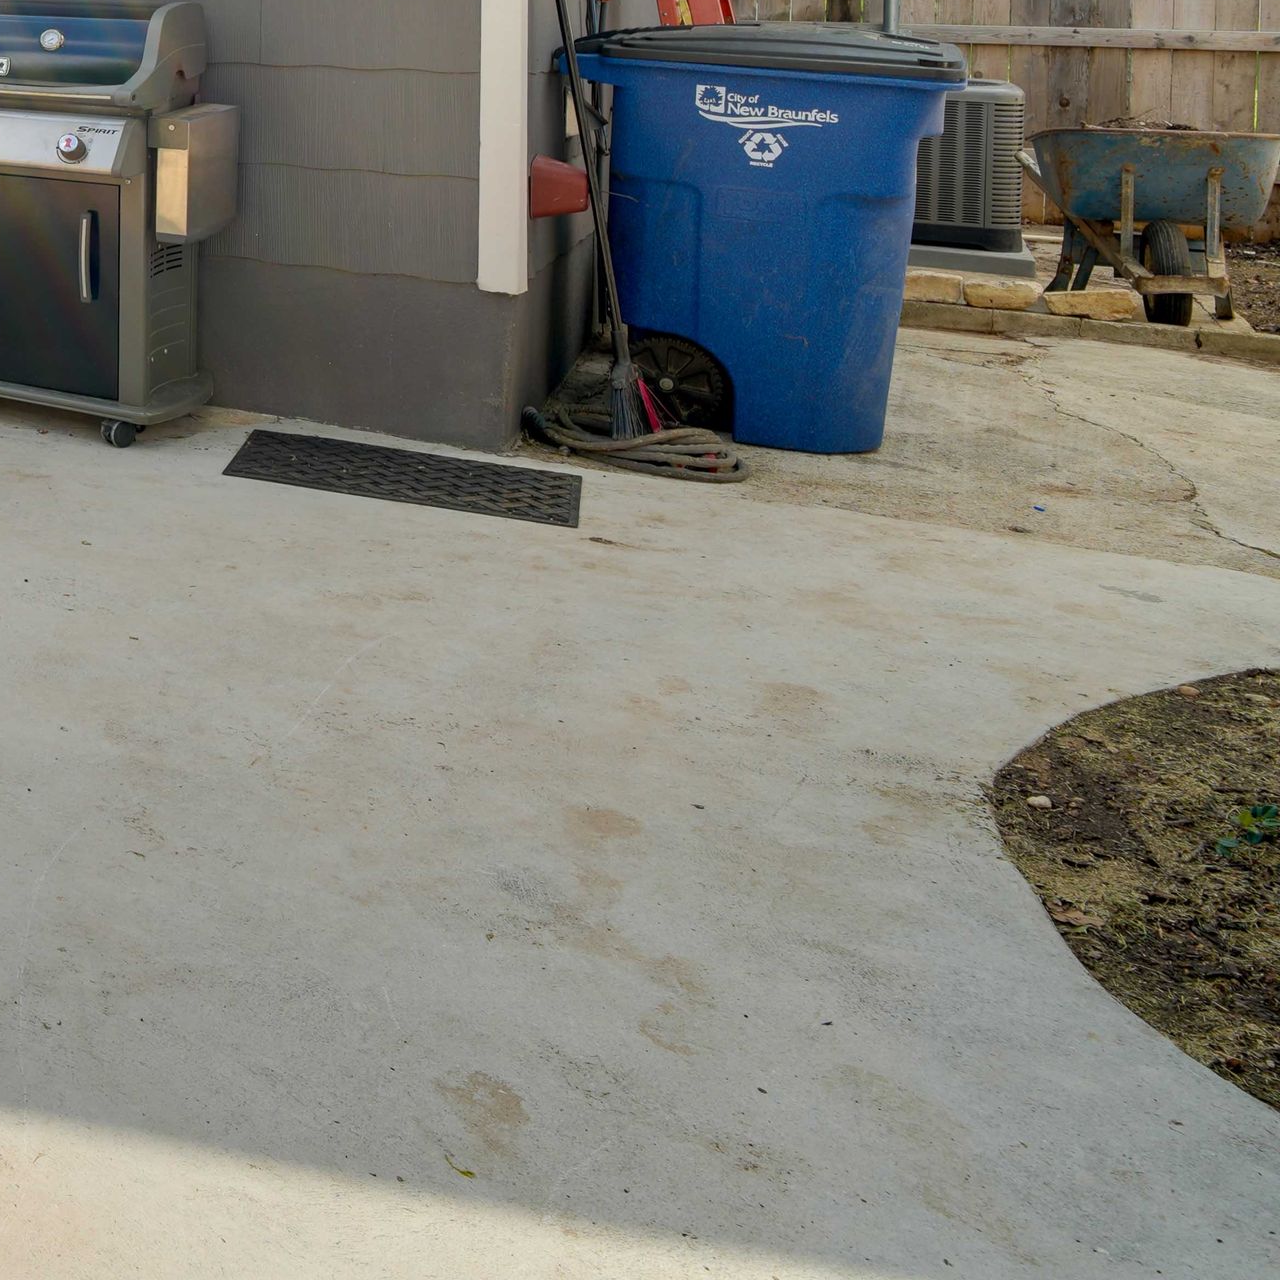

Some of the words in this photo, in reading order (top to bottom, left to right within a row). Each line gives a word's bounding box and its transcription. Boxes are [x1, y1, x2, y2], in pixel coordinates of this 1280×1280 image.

[727, 92, 747, 104] City
[748, 94, 760, 104] of
[727, 104, 765, 117] New
[767, 105, 840, 124] Braunfels
